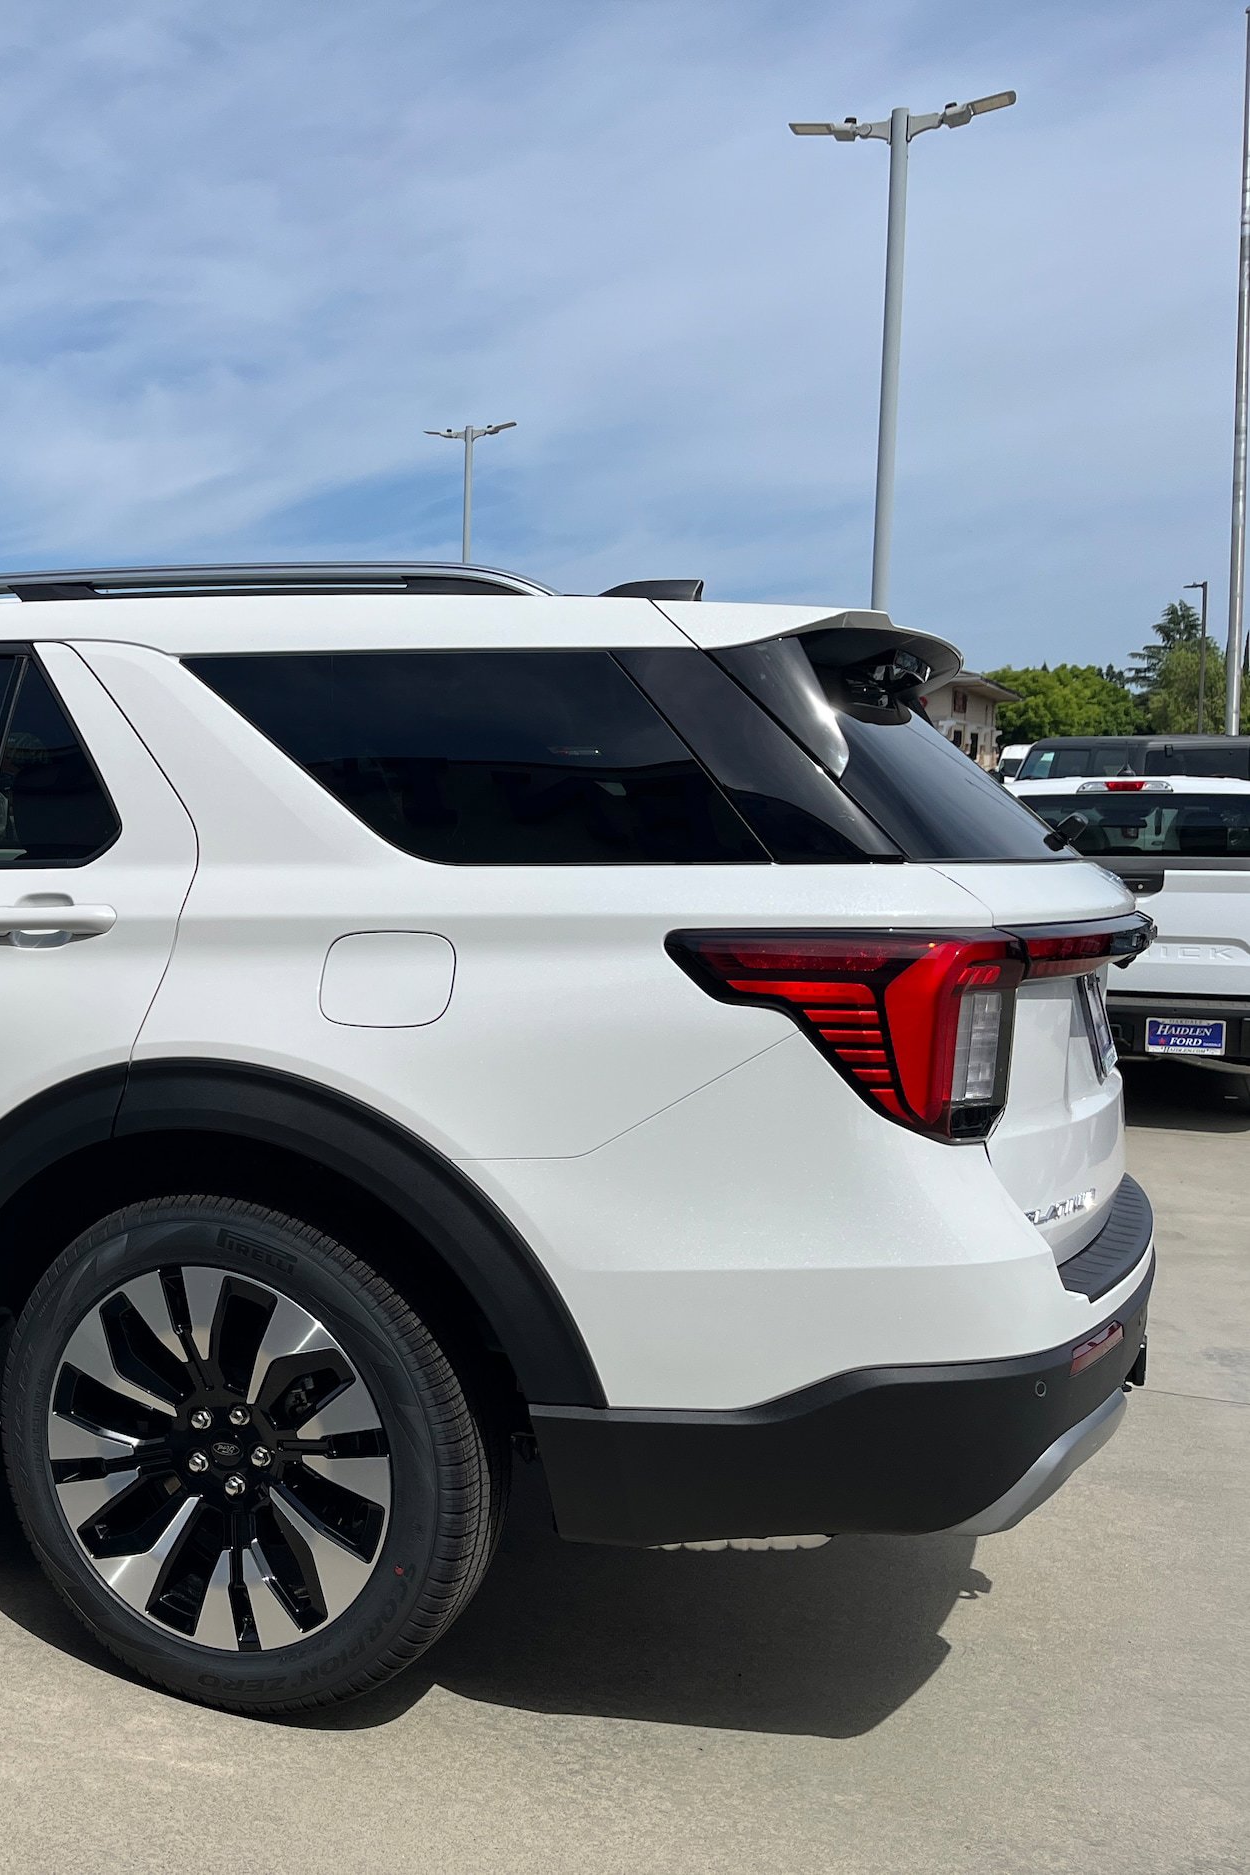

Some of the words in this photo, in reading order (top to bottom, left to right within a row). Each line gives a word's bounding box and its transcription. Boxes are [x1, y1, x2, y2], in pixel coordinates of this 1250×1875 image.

[1155, 1024, 1213, 1036] HAIDLEN
[1169, 1037, 1203, 1047] FORD
[216, 1228, 298, 1275] PIRELLI
